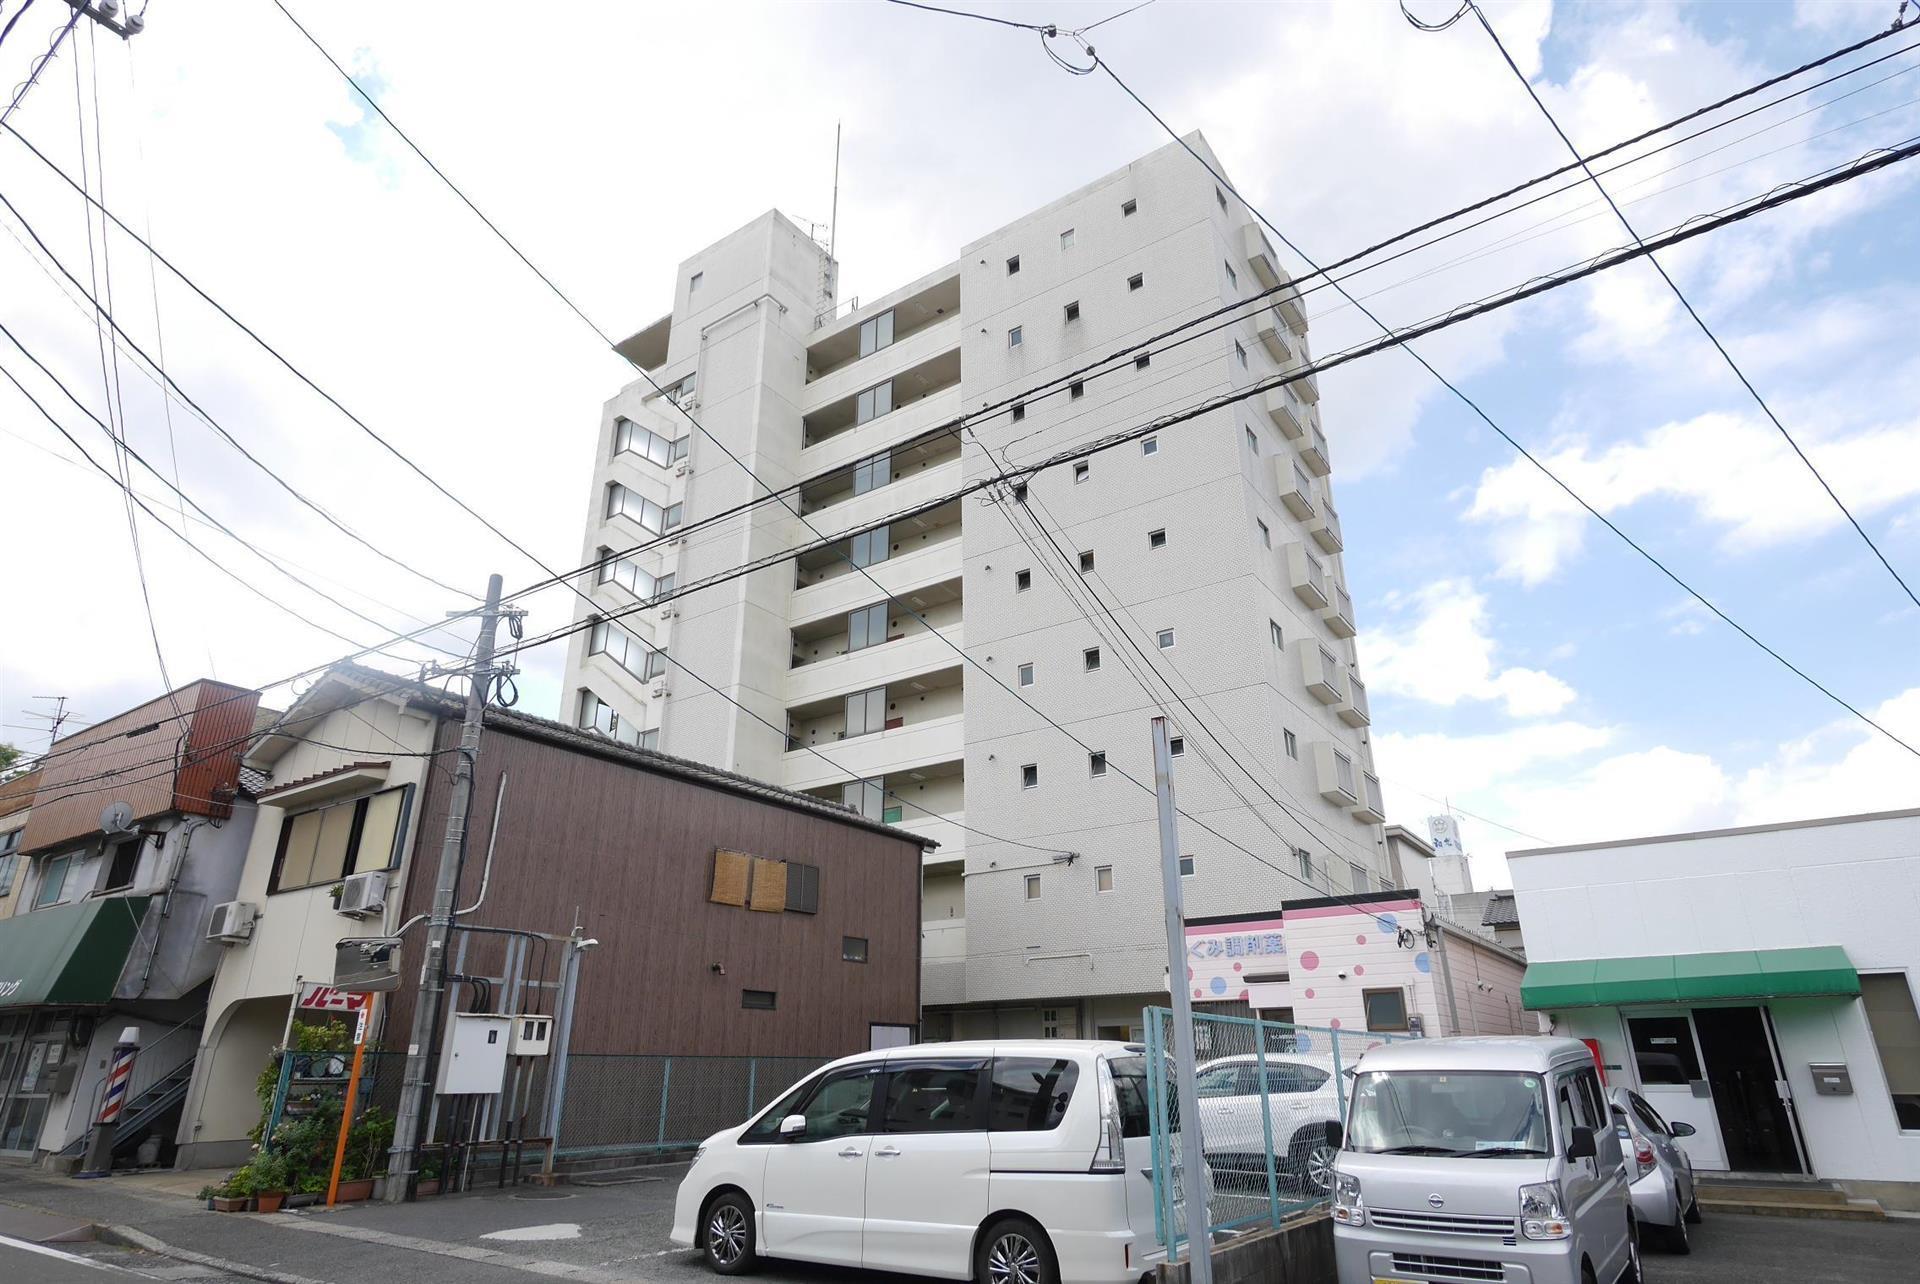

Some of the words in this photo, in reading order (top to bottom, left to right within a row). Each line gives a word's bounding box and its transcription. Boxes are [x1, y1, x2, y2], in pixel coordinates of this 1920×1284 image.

[1187, 933, 1287, 958] ぐみ調剤薬
[301, 986, 368, 1010] パーマ
